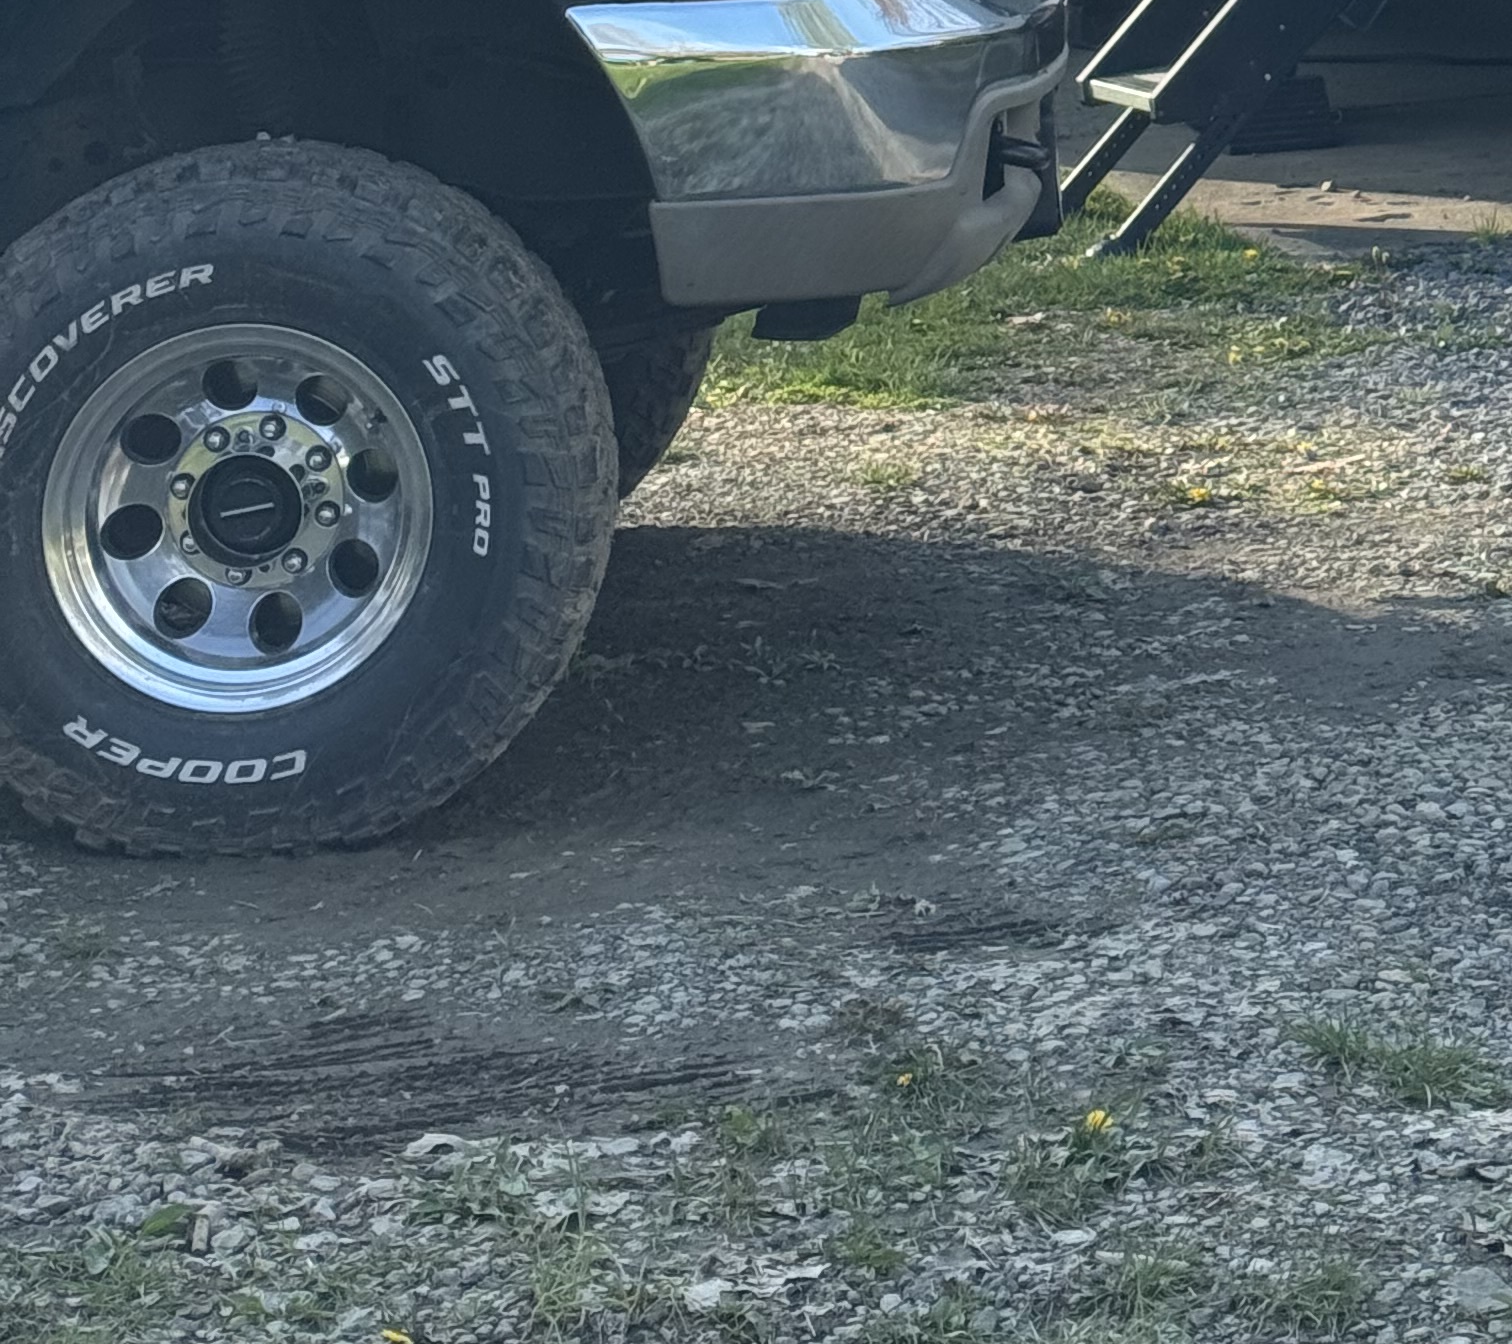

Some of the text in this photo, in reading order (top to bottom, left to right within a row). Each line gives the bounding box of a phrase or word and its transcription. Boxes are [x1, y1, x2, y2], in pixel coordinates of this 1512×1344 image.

[422, 354, 491, 557] STT PRO
[62, 715, 307, 784] COOPER
